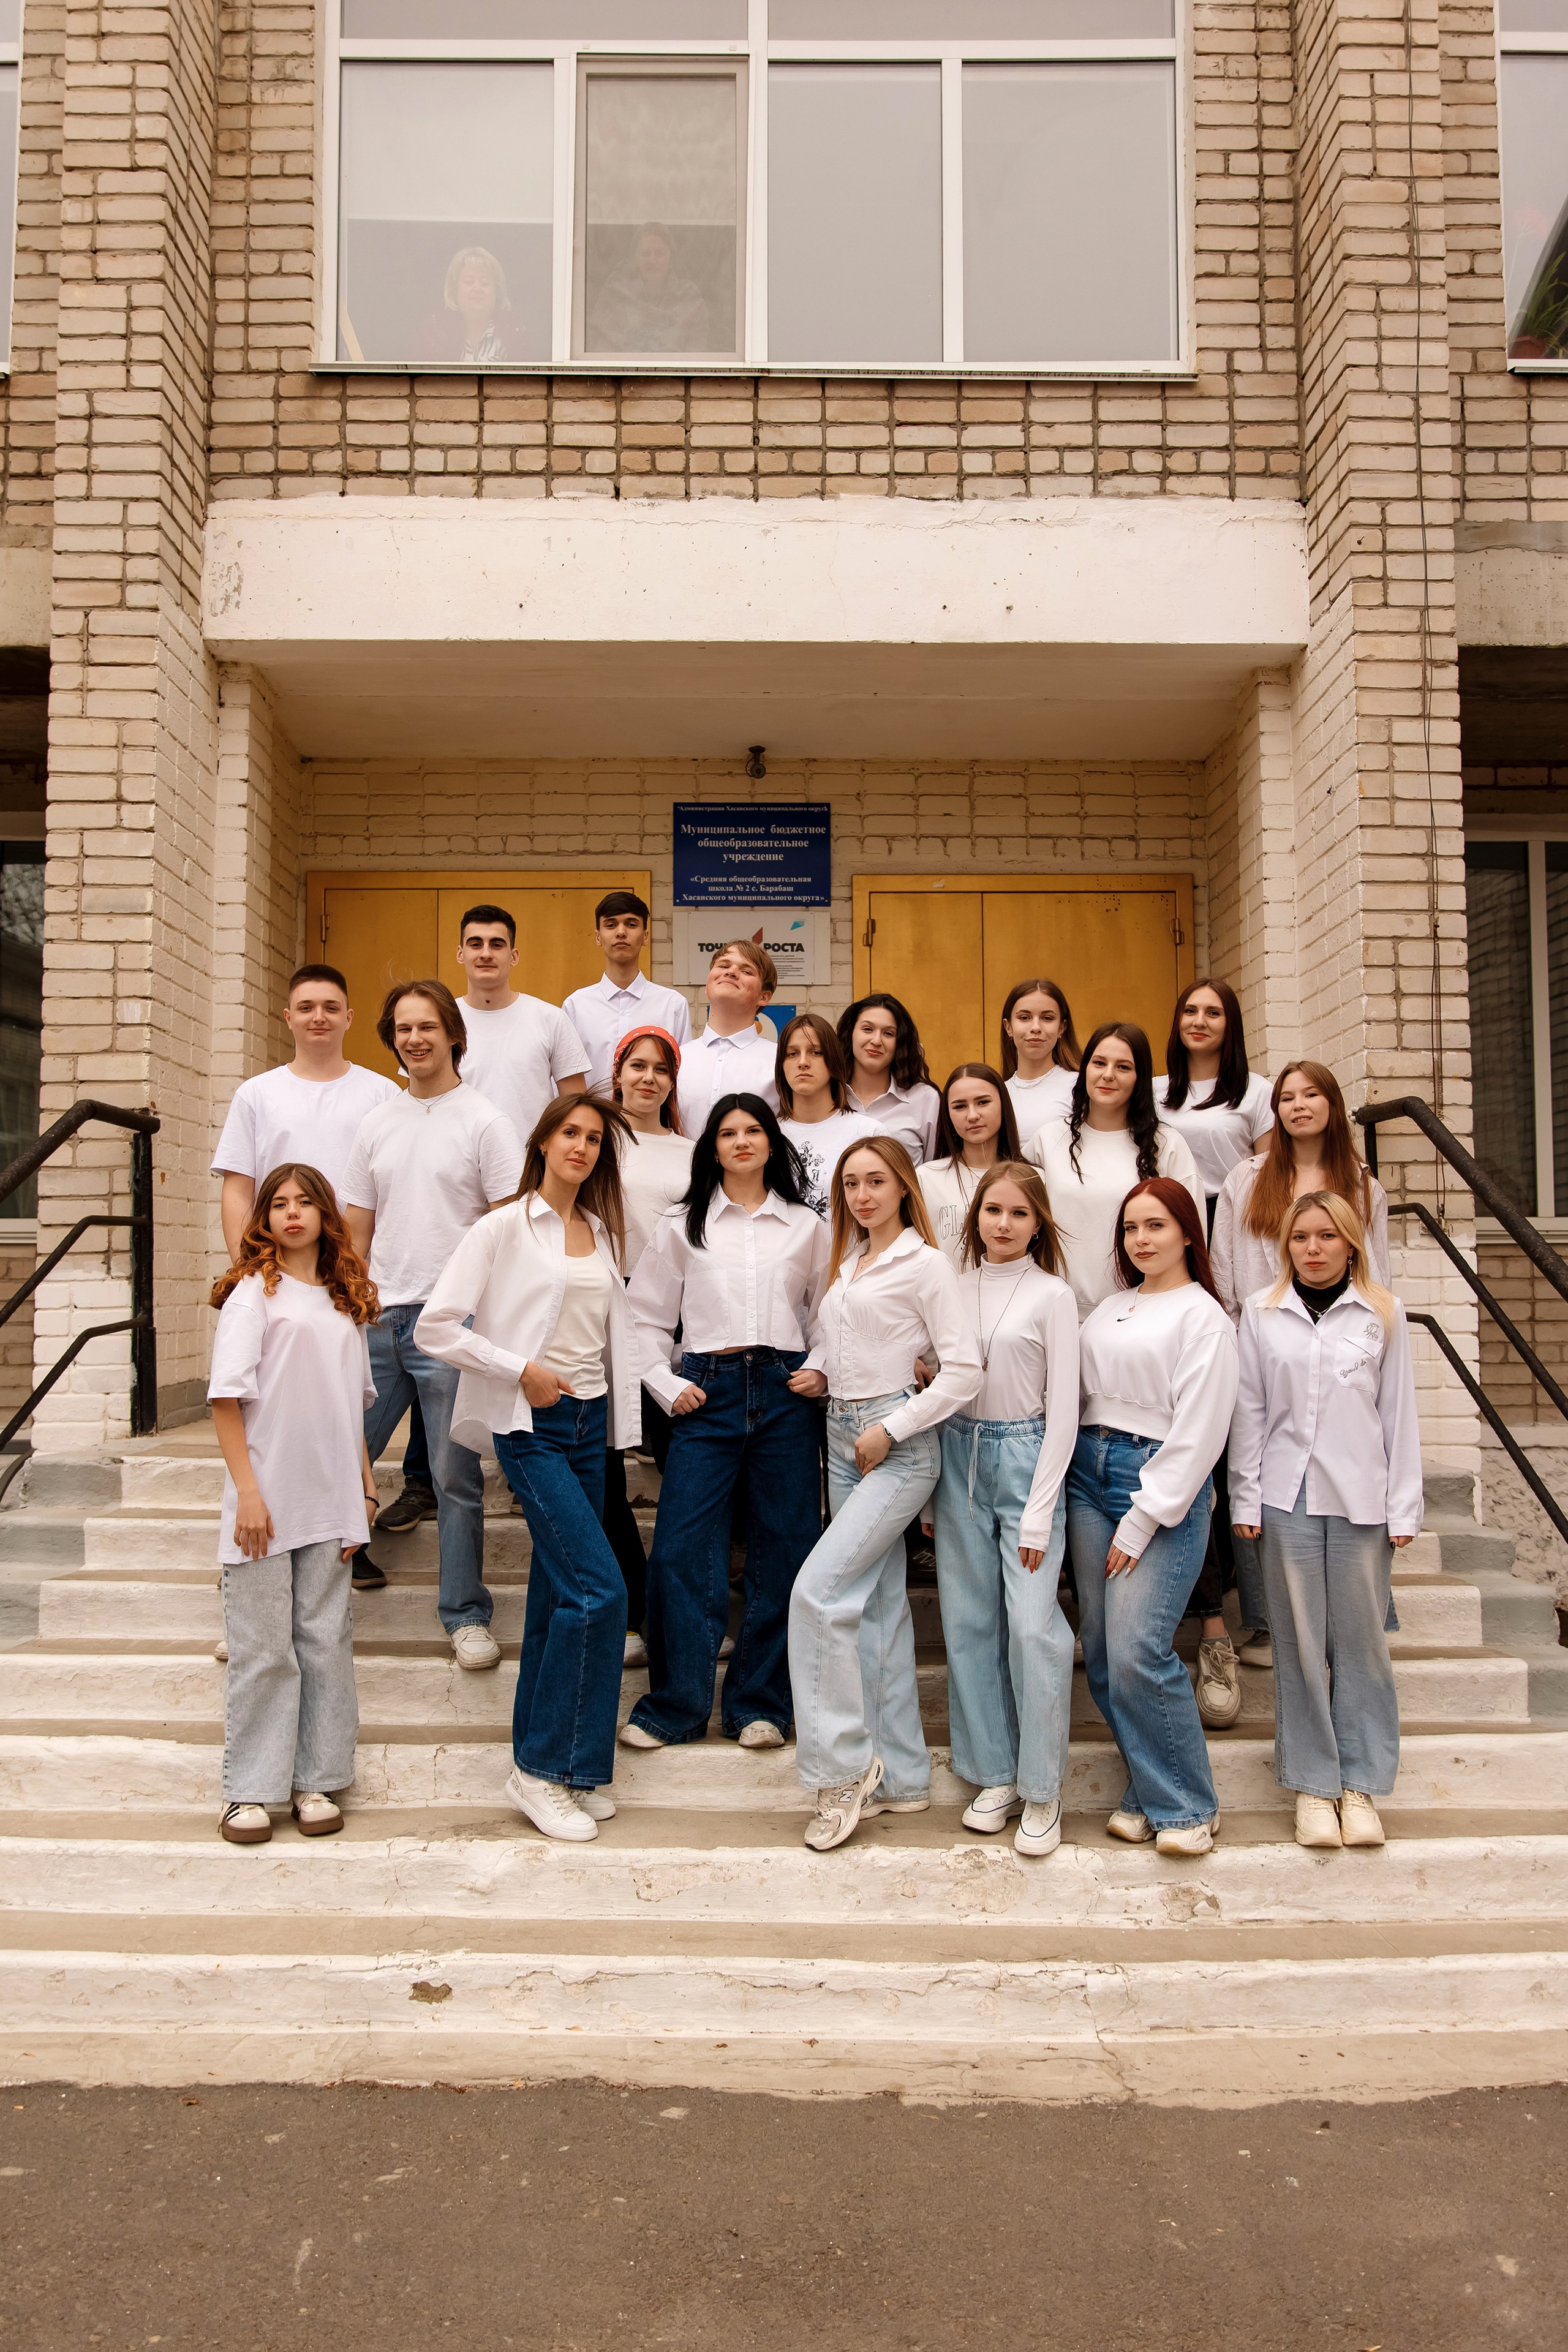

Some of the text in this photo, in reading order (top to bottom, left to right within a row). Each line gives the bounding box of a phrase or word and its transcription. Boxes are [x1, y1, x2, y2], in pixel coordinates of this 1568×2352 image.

[680, 824, 826, 835] Муниципальное бюджетное
[698, 838, 809, 850] общеобразовательное
[723, 854, 784, 863] учреждение
[690, 875, 727, 884] «Средняя
[760, 884, 794, 893] Барабаш
[698, 943, 805, 952] ТОЧ РОСТА
